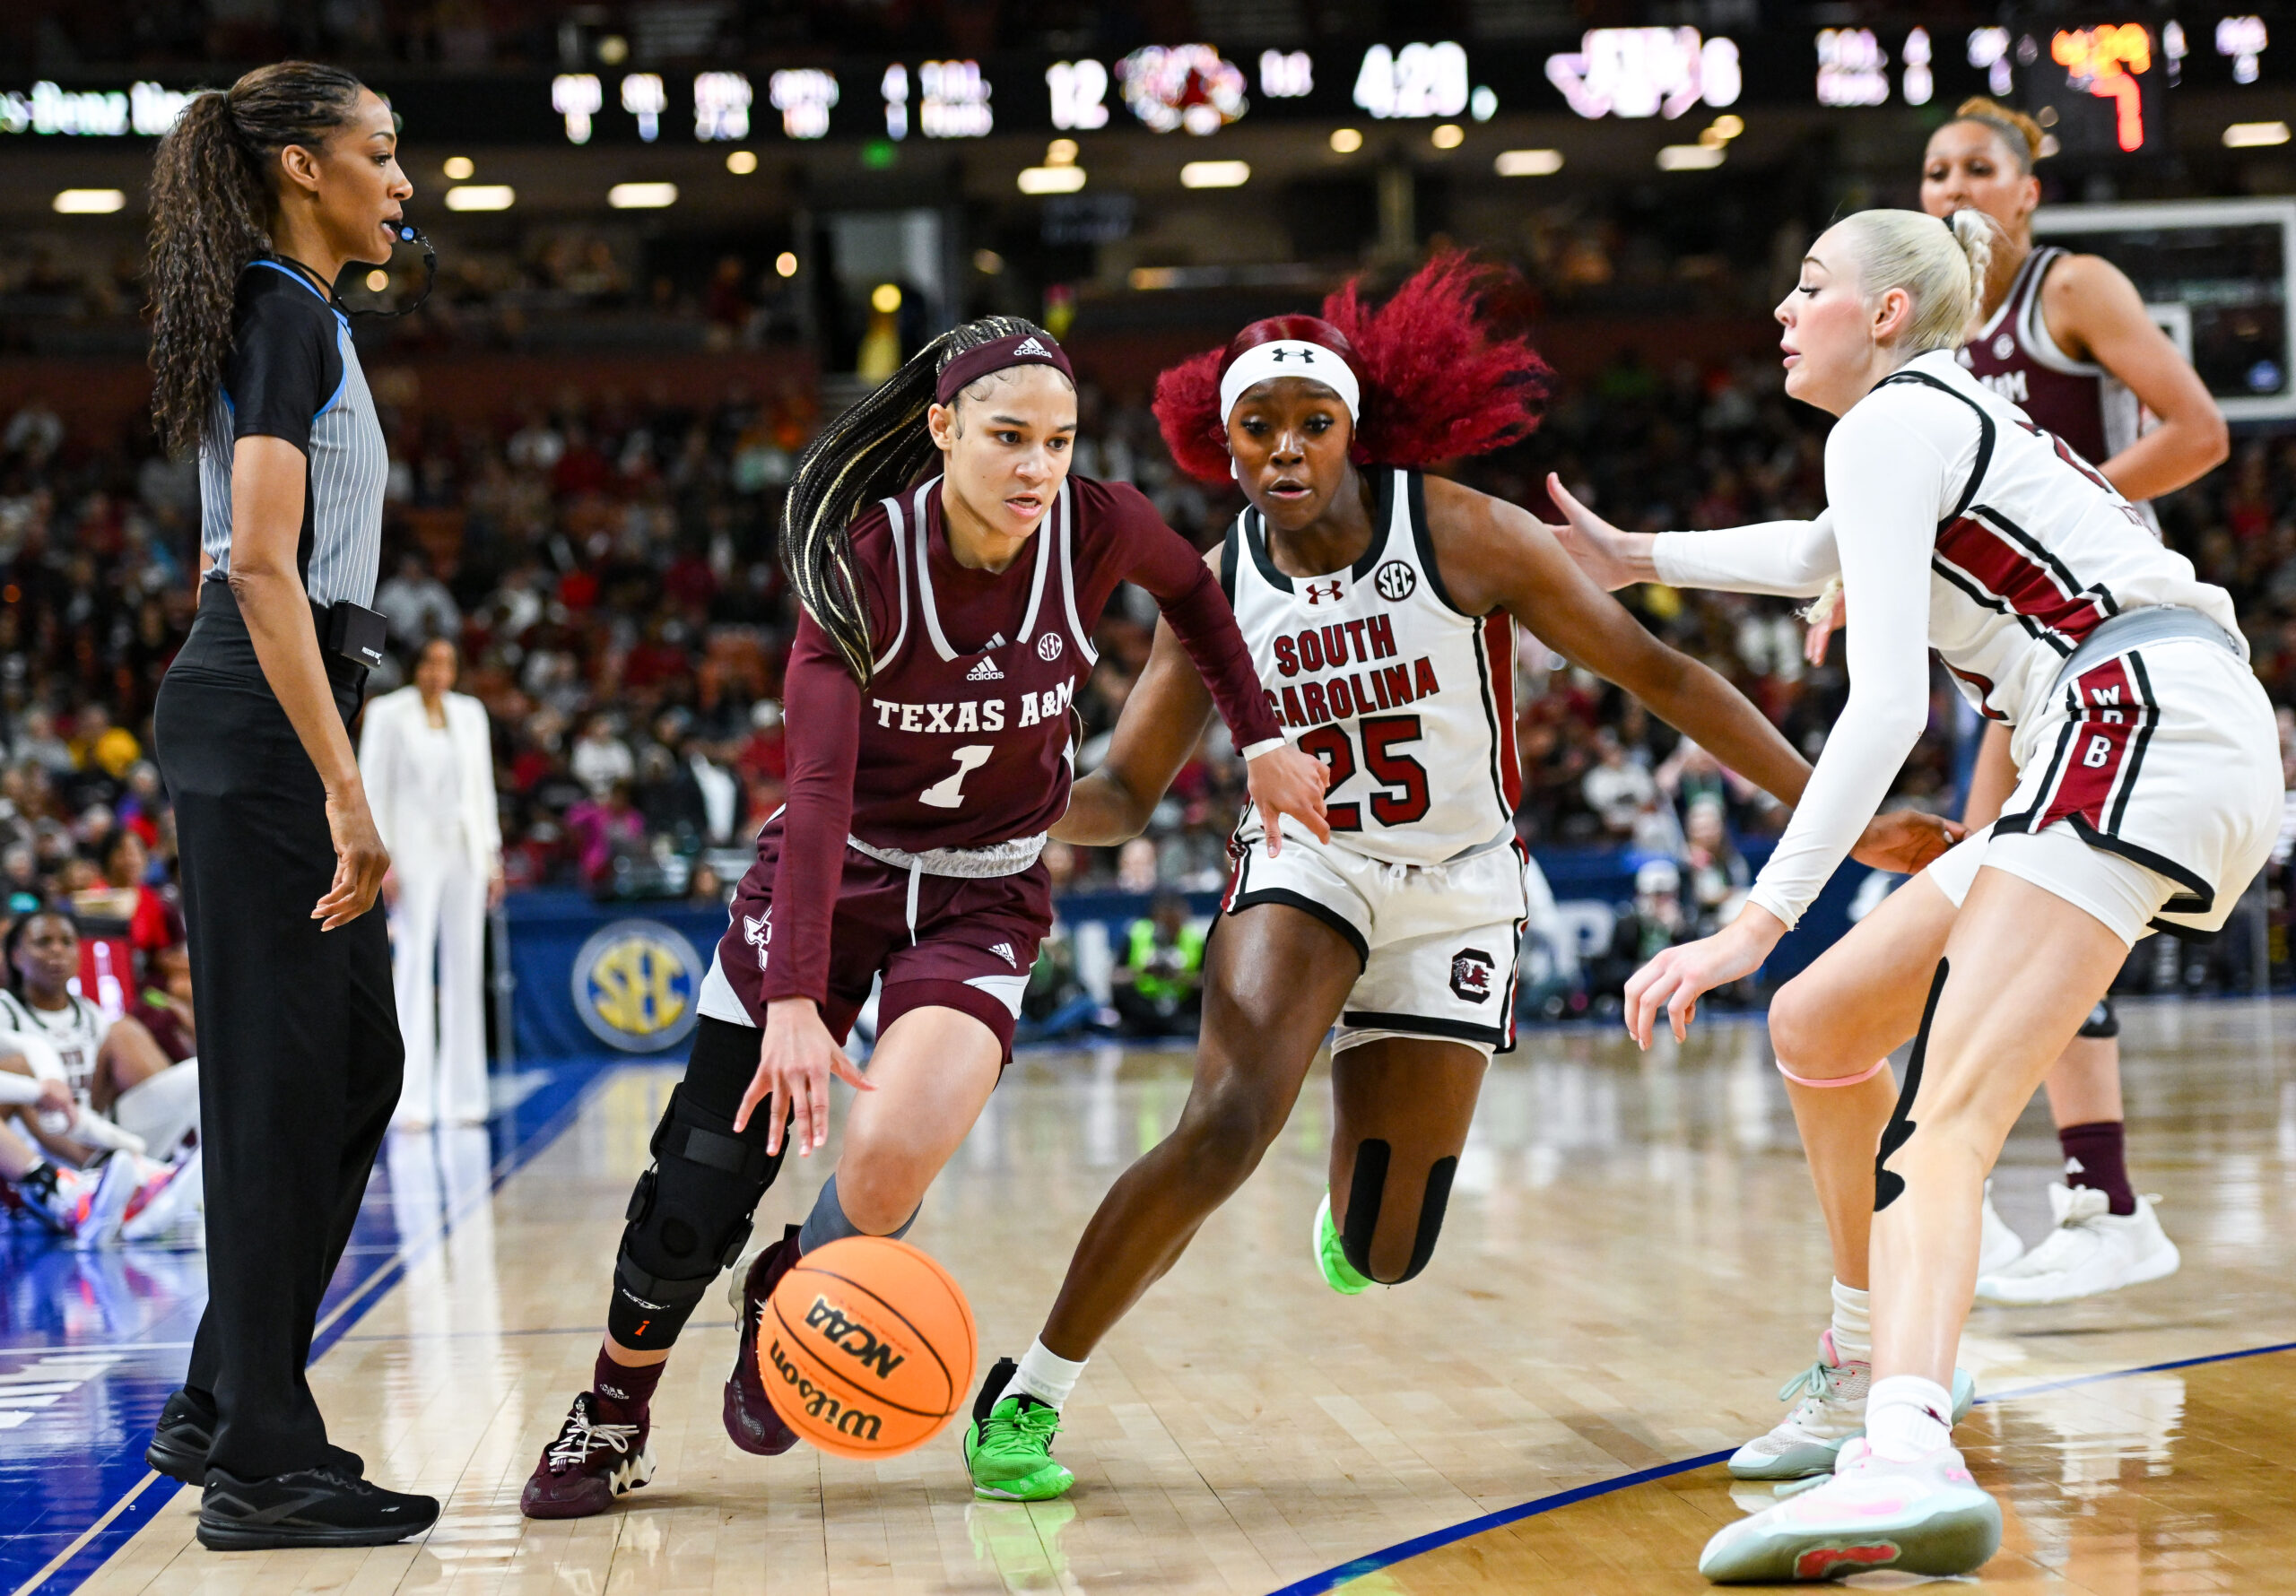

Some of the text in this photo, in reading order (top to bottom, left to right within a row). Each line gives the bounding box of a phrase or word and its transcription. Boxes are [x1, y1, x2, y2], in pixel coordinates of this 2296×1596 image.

[1013, 348, 1053, 359] adidas
[1377, 561, 1414, 599] SEC
[966, 670, 1004, 681] adidas
[1039, 633, 1062, 661] SEC
[1274, 613, 1397, 677] SOUTH
[873, 674, 1075, 733] TEXAS A&M
[1263, 655, 1440, 728] CAROLINA
[918, 744, 995, 809] 1
[1297, 714, 1431, 832] 25
[589, 935, 688, 1037] SEC
[804, 1297, 905, 1381] NCAA
[599, 1383, 630, 1400] adidas
[770, 1339, 883, 1442] Wilson
